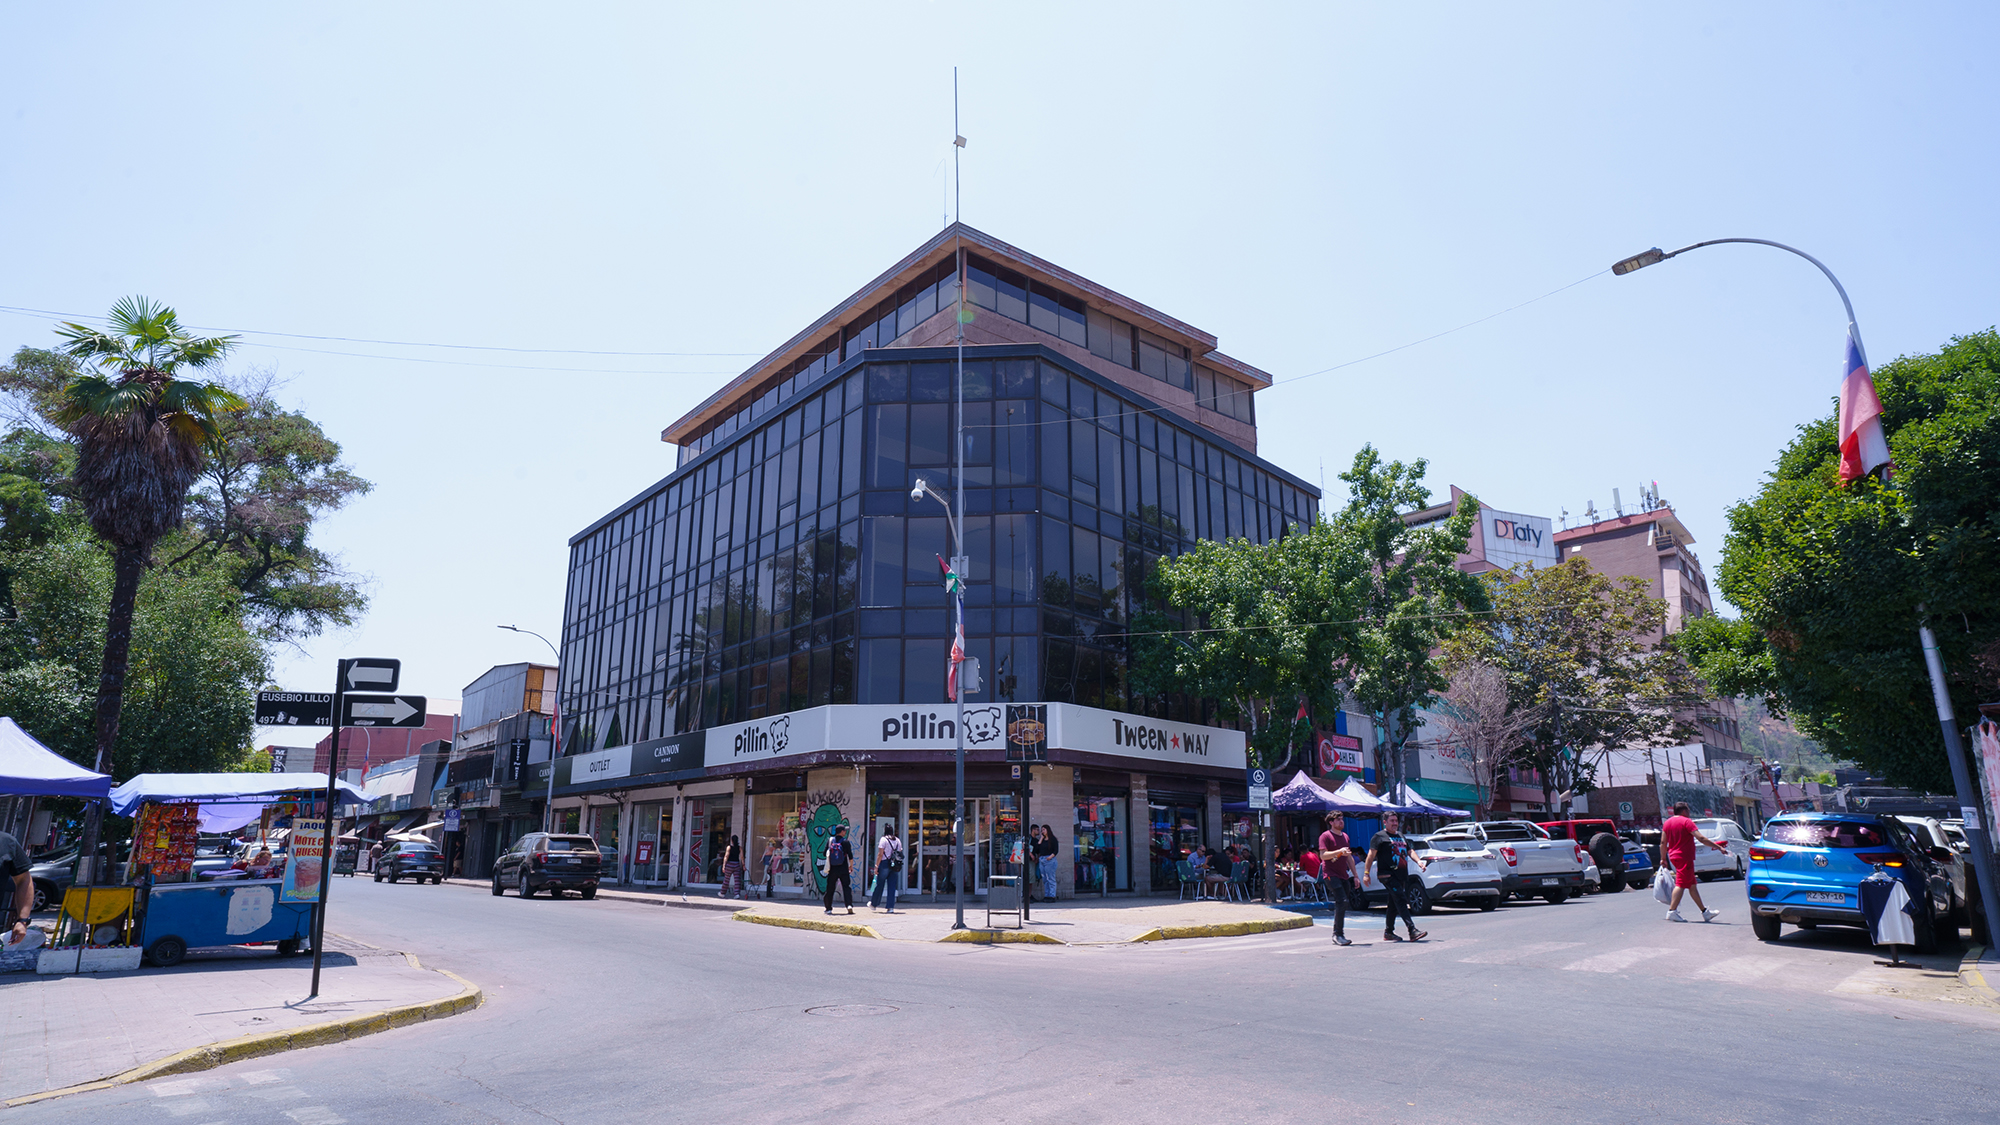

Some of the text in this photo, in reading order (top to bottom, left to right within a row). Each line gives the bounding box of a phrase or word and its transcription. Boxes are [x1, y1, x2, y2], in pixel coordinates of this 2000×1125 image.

[261, 693, 331, 703] EUSEBIO LILLO
[258, 716, 329, 725] 497 411
[882, 711, 956, 742] pillin
[734, 726, 768, 757] pillin
[1182, 732, 1209, 756] WAY
[654, 743, 680, 758] CANNON
[1339, 751, 1356, 765] AHLEN
[589, 759, 611, 773] OUTLET
[294, 835, 316, 846] MOTE
[688, 800, 704, 883] SALE
